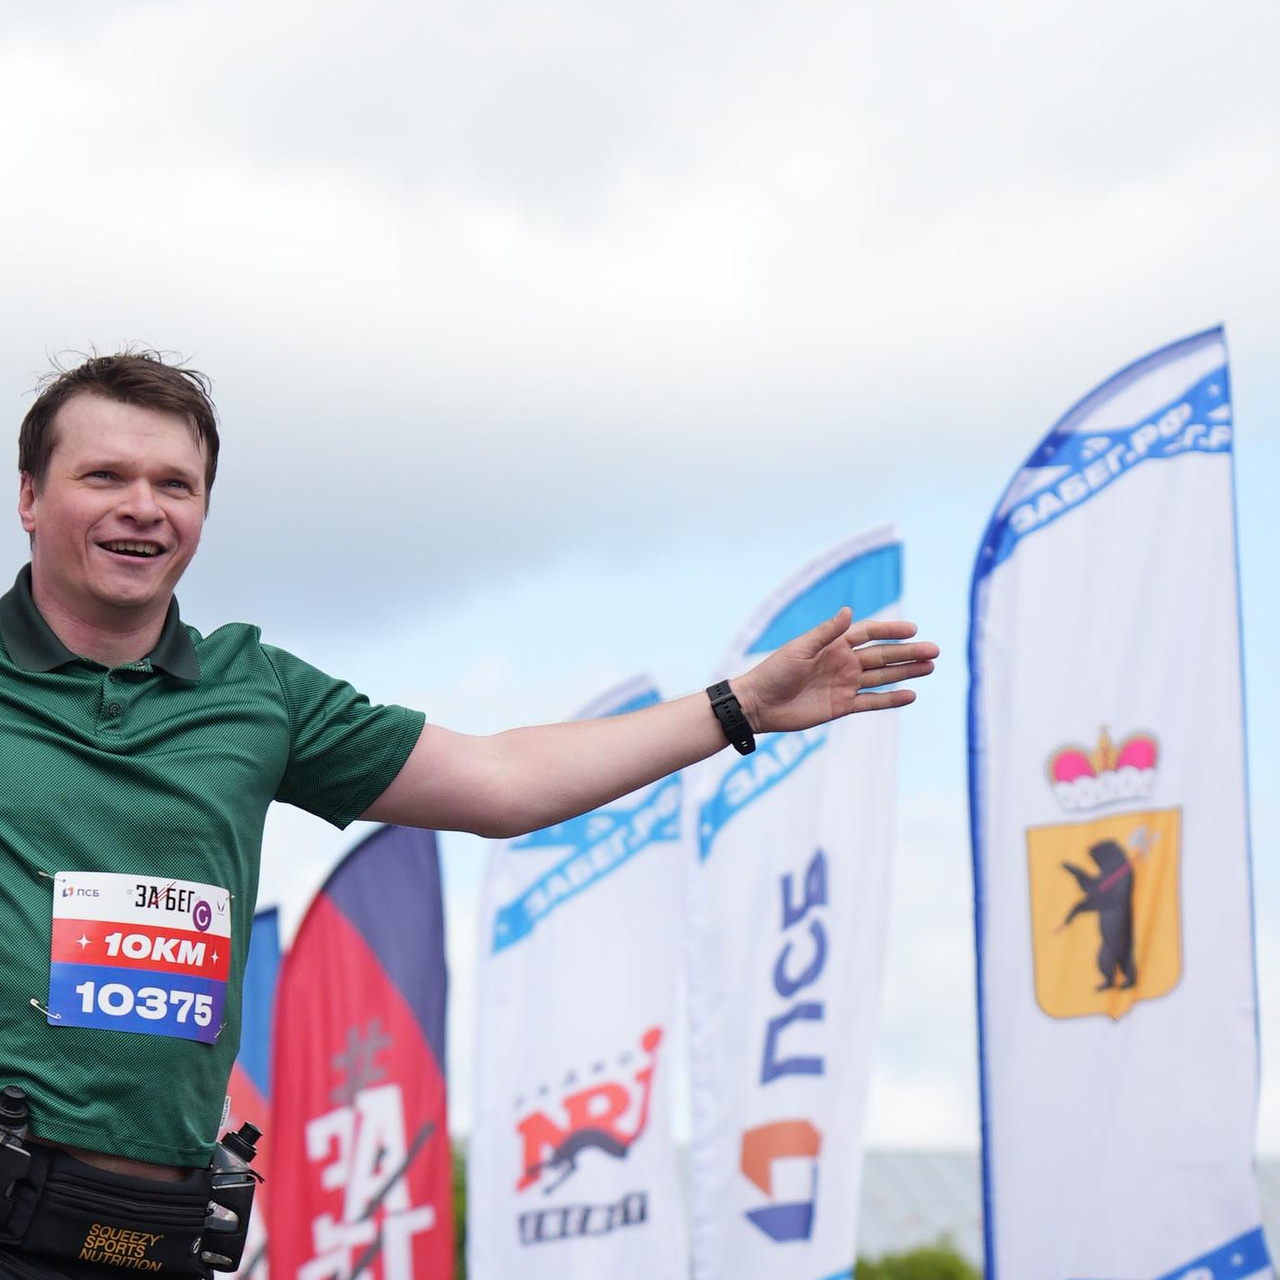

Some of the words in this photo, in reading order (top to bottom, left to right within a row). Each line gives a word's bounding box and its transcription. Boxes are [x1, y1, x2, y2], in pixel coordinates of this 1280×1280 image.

[75, 981, 214, 1027] 10375
[84, 1235, 146, 1258] SPORTS
[89, 1223, 160, 1247] SQUEEZY
[78, 1247, 163, 1271] NUTRITION
